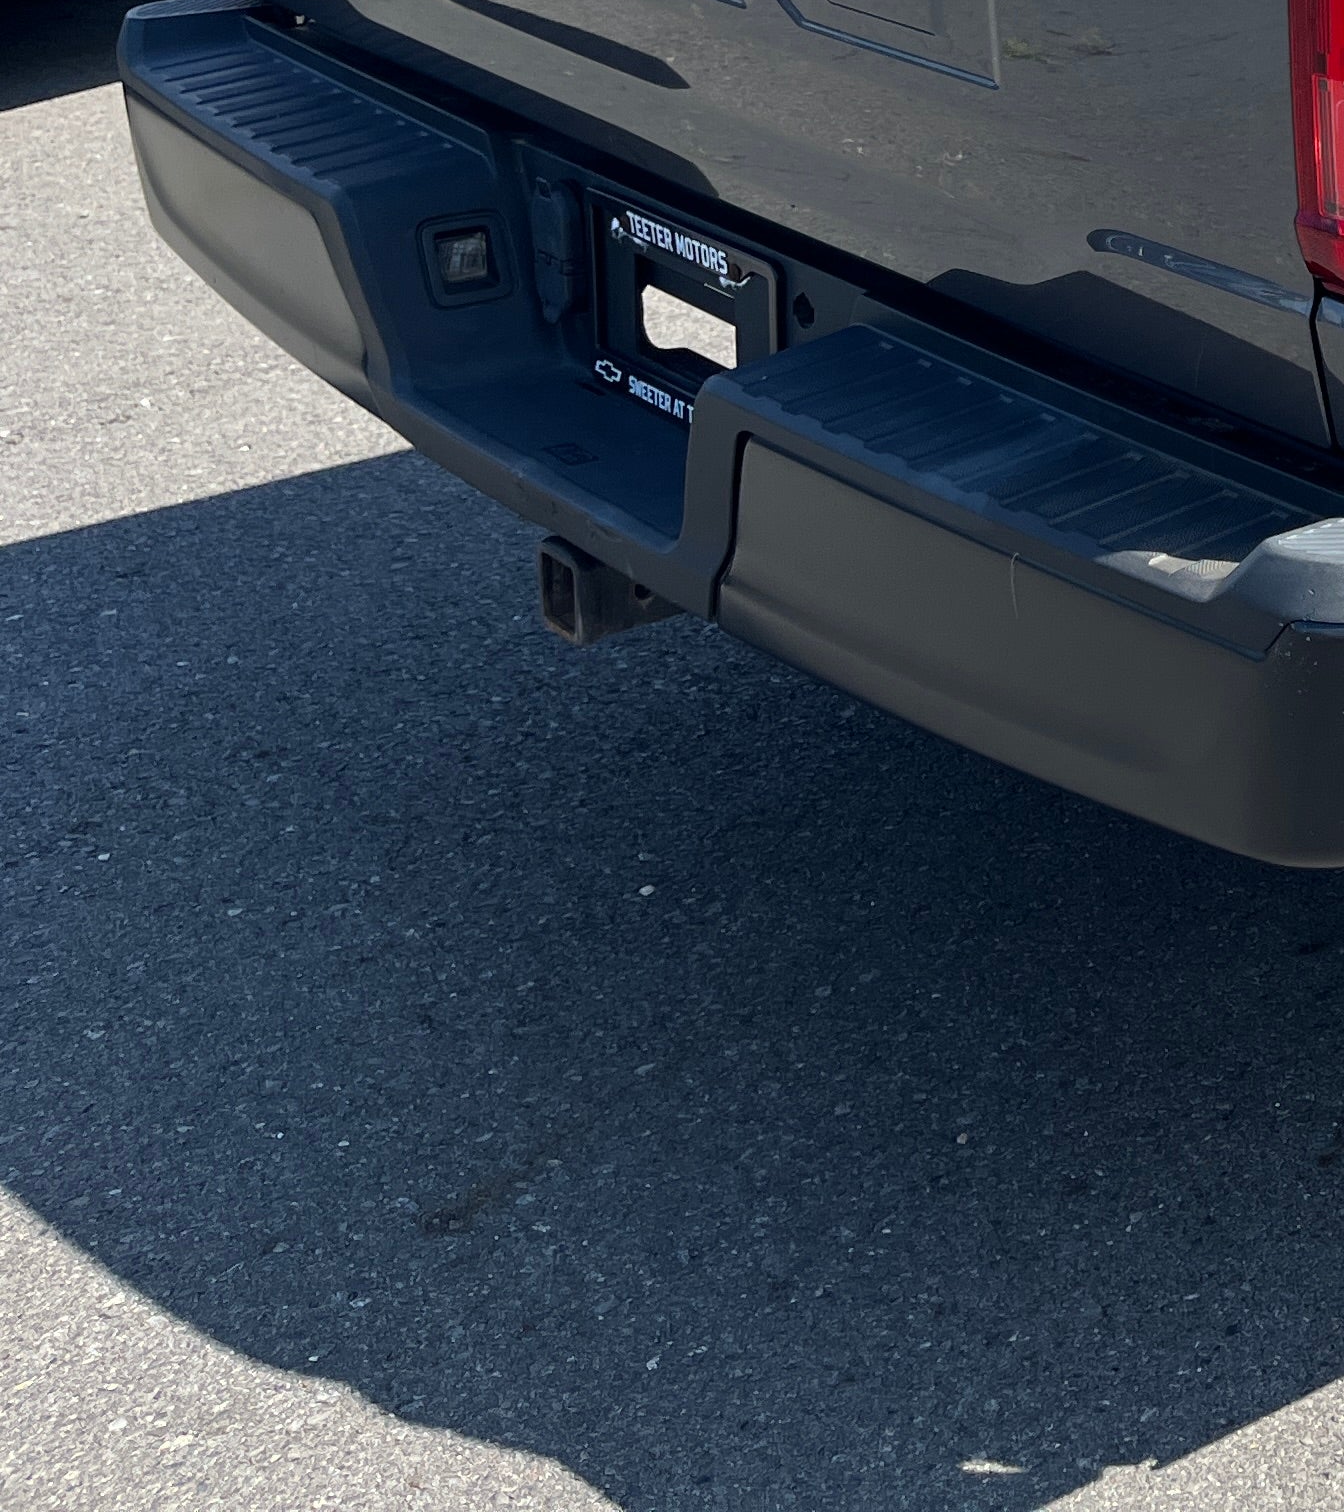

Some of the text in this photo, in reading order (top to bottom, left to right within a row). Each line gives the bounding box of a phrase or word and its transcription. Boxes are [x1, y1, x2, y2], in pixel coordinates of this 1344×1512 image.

[626, 210, 728, 275] TEETER MOTORS
[628, 375, 672, 414] SWEETER
[672, 398, 685, 419] AT
